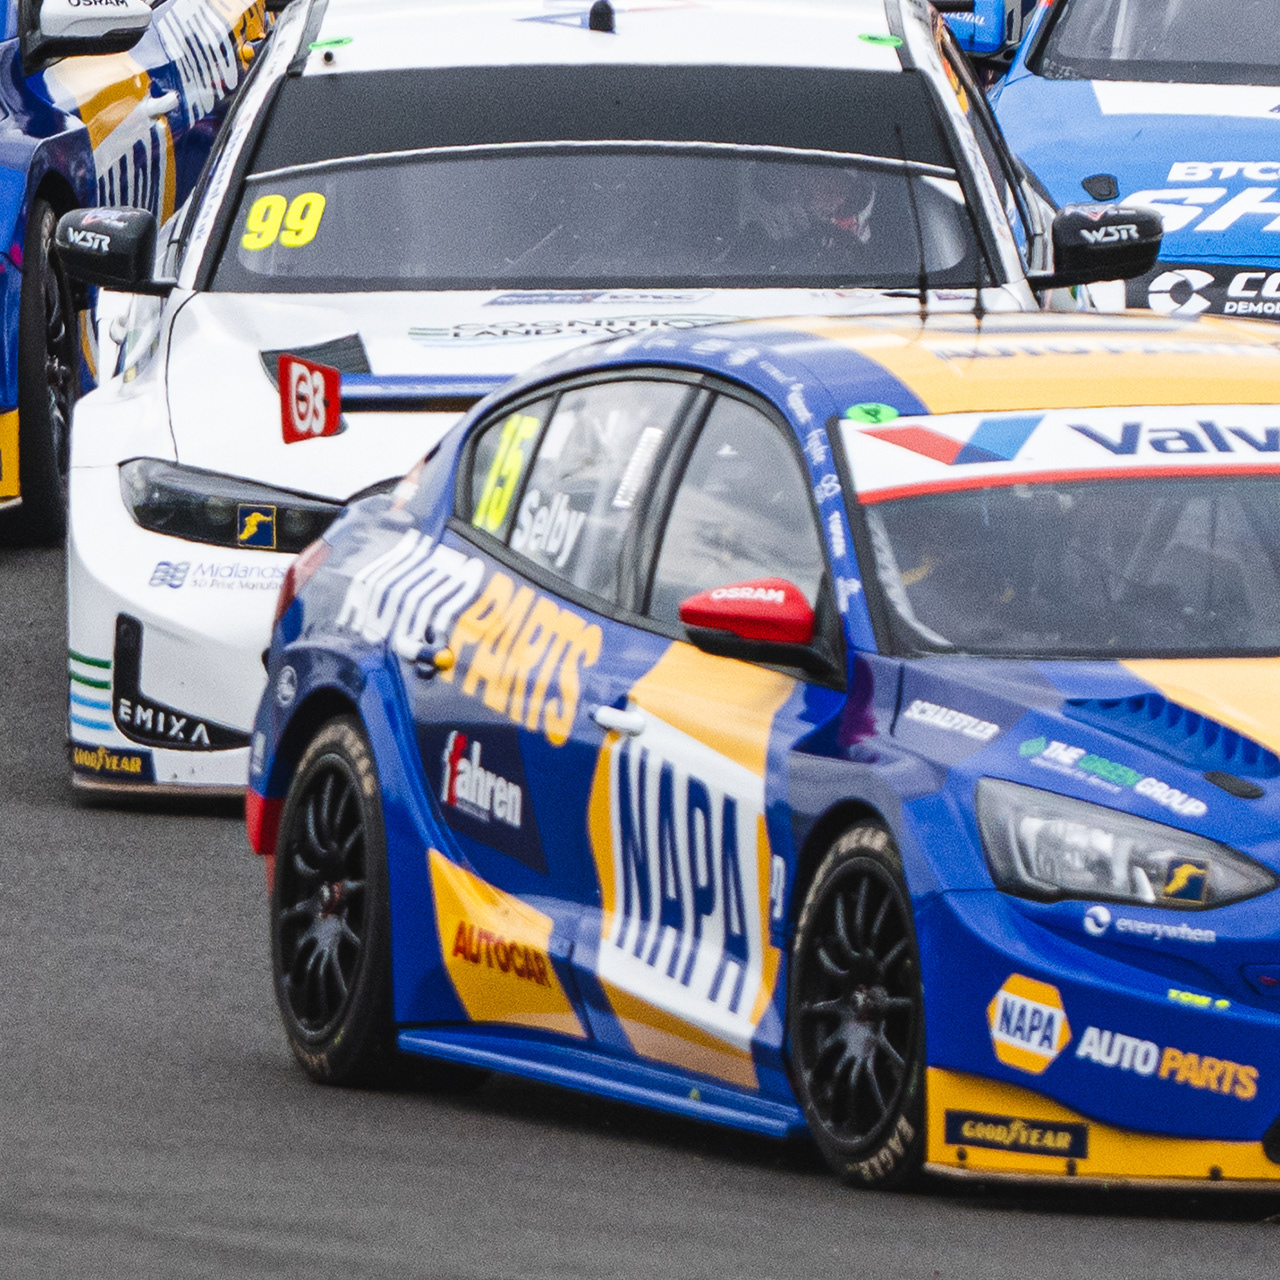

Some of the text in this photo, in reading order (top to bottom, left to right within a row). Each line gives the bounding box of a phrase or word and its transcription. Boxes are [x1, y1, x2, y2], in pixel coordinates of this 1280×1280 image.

[66, 226, 111, 253] WSR
[241, 191, 326, 250] 99
[1080, 223, 1140, 245] WSR
[511, 490, 588, 569] Selby
[193, 561, 285, 580] Midlands
[710, 585, 785, 604] OSRAM
[336, 529, 605, 749] AUTO PARTS
[119, 699, 211, 746] EMIXA
[903, 699, 1000, 742] SCHAEFFLER
[73, 747, 142, 774] GOODYEAR
[1134, 777, 1208, 819] GROUP
[615, 735, 750, 1014] NAPA
[1115, 916, 1217, 945] everywhen
[451, 919, 552, 989] AUTOCAR
[995, 1002, 1062, 1051] NAPA
[1074, 1026, 1260, 1101] AUTO PARTS
[960, 1117, 1074, 1154] GOODYEAR
